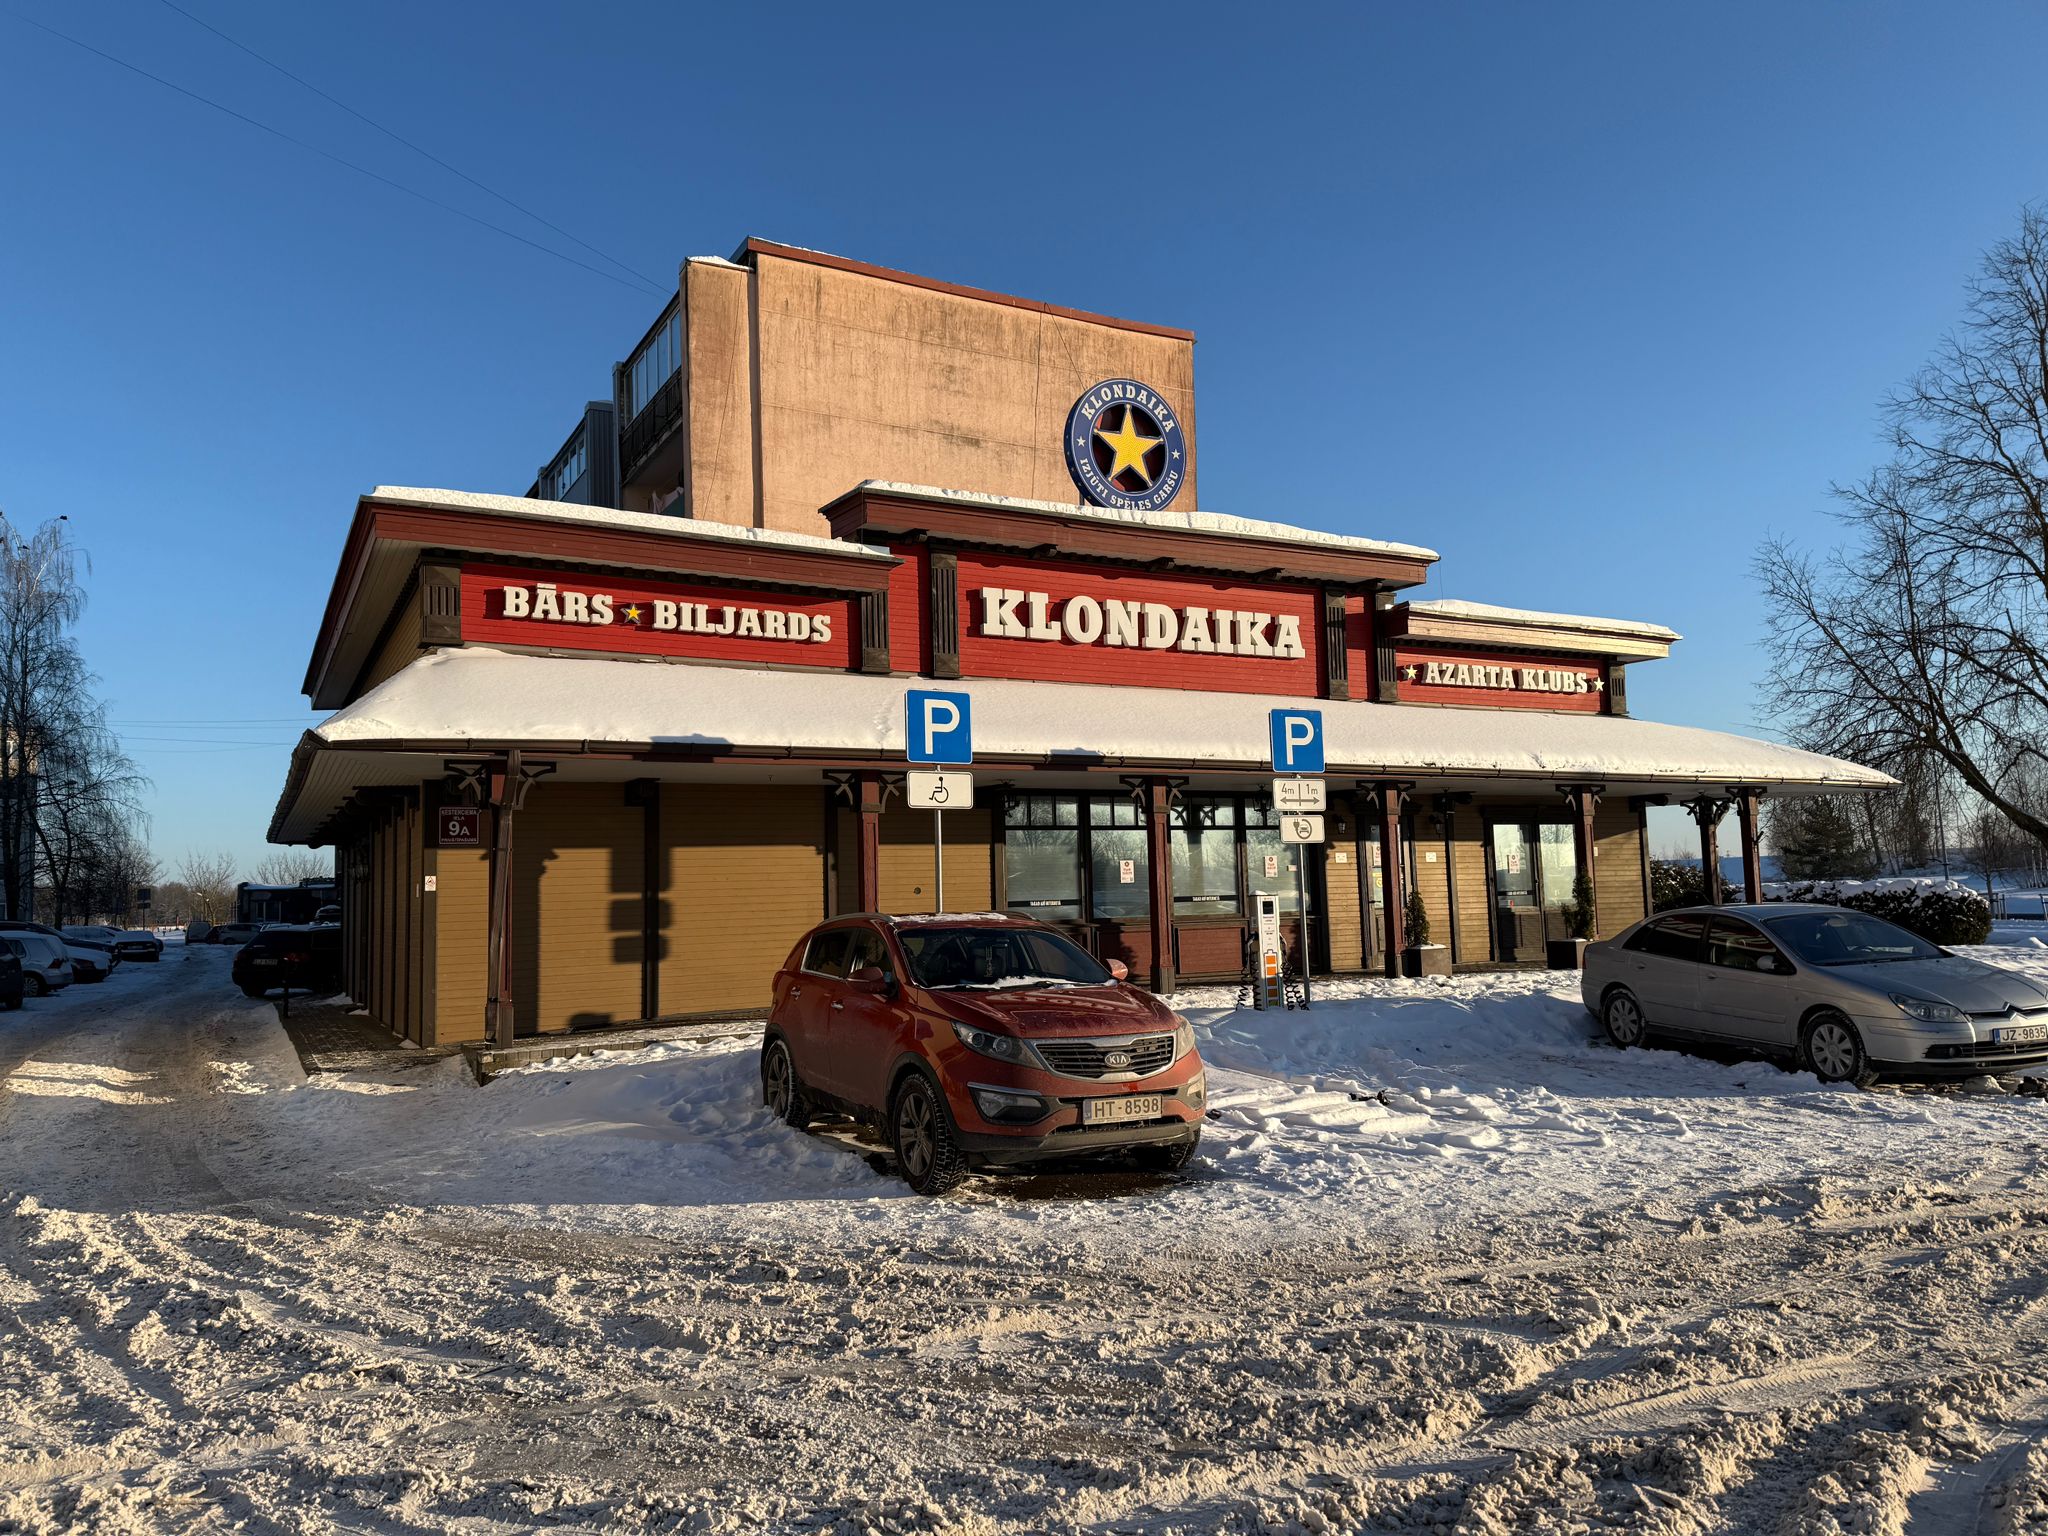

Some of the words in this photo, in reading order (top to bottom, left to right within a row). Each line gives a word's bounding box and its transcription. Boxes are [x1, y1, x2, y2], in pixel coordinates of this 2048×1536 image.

[1081, 384, 1175, 432] KLONDAIKA
[1080, 458, 1109, 498] IZJŪTI
[1110, 495, 1152, 510] SPĒLES
[1153, 470, 1178, 504] GARŠU
[503, 583, 614, 625] BĀRS
[652, 599, 832, 643] BILJARDS
[981, 586, 1306, 658] KLONDAIKA
[1423, 661, 1516, 689] AZARTA
[1520, 668, 1588, 693] KLUBS
[924, 699, 960, 754] P
[1285, 716, 1314, 765] P
[1281, 783, 1295, 795] 4m
[1306, 783, 1318, 795] 1m
[448, 821, 470, 836] 9A
[2002, 1026, 2046, 1041] JZ-9835
[1109, 1055, 1127, 1064] KIA
[1094, 1098, 1159, 1118] HT-8598
